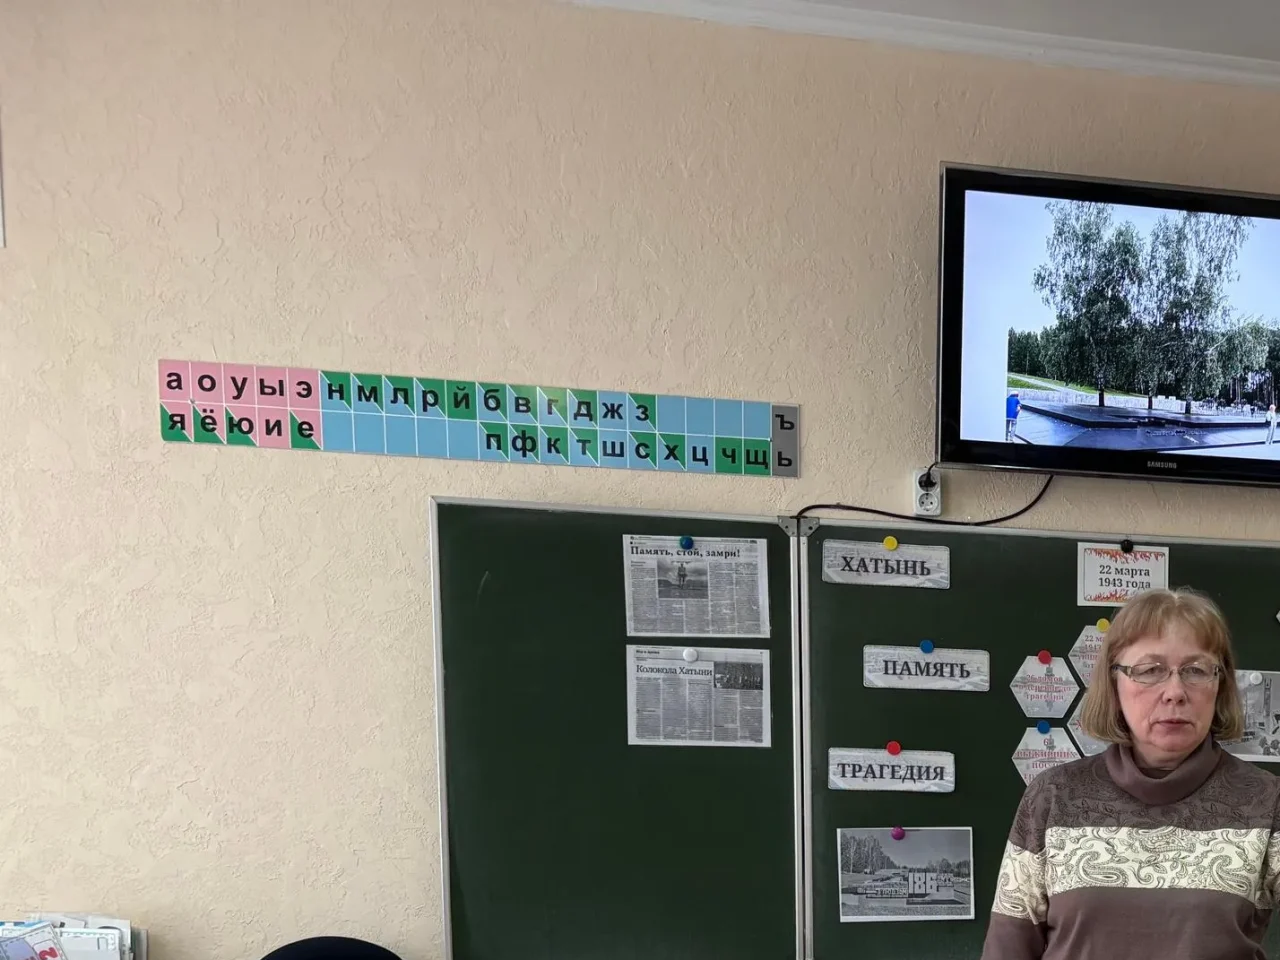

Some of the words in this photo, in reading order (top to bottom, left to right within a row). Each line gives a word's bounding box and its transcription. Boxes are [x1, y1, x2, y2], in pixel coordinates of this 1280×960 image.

[166, 372, 183, 390] а
[197, 374, 217, 392] о
[230, 376, 248, 400] у
[259, 378, 284, 397] ы
[296, 380, 313, 399] э
[327, 382, 345, 401] н
[357, 384, 379, 404] м
[390, 386, 410, 405] л
[421, 389, 440, 413] р
[453, 385, 470, 410] й
[483, 388, 502, 412] б
[514, 396, 532, 414] в
[547, 397, 559, 415] г
[573, 400, 594, 422] д
[602, 402, 623, 420] ж
[635, 404, 650, 422] з
[168, 413, 186, 431] я
[200, 409, 217, 433] ё
[228, 416, 254, 435] ю
[265, 419, 282, 437] и
[297, 421, 314, 439] е
[485, 433, 503, 451] п
[511, 429, 537, 458] ф
[547, 437, 561, 454] к
[576, 438, 592, 455] т
[602, 440, 625, 458] ш
[635, 442, 651, 460] с
[664, 443, 681, 462] х
[692, 446, 709, 467] ц
[721, 447, 737, 465] ч
[745, 448, 770, 471] щ
[1147, 461, 1177, 469] SAMSUNG
[630, 546, 674, 556] Память,
[676, 549, 703, 558] стой,
[705, 550, 741, 559] замри!
[840, 556, 931, 577] ХАТЫНЬ
[1099, 565, 1112, 575] 22
[1114, 567, 1150, 578] марта
[1099, 578, 1123, 588] 1943
[1126, 581, 1151, 590] года
[636, 664, 677, 675] Колокола
[678, 666, 713, 676] Хатыни
[882, 659, 971, 679] ПАМЯТЬ
[837, 763, 946, 784] ТРАГЕДИЯ
